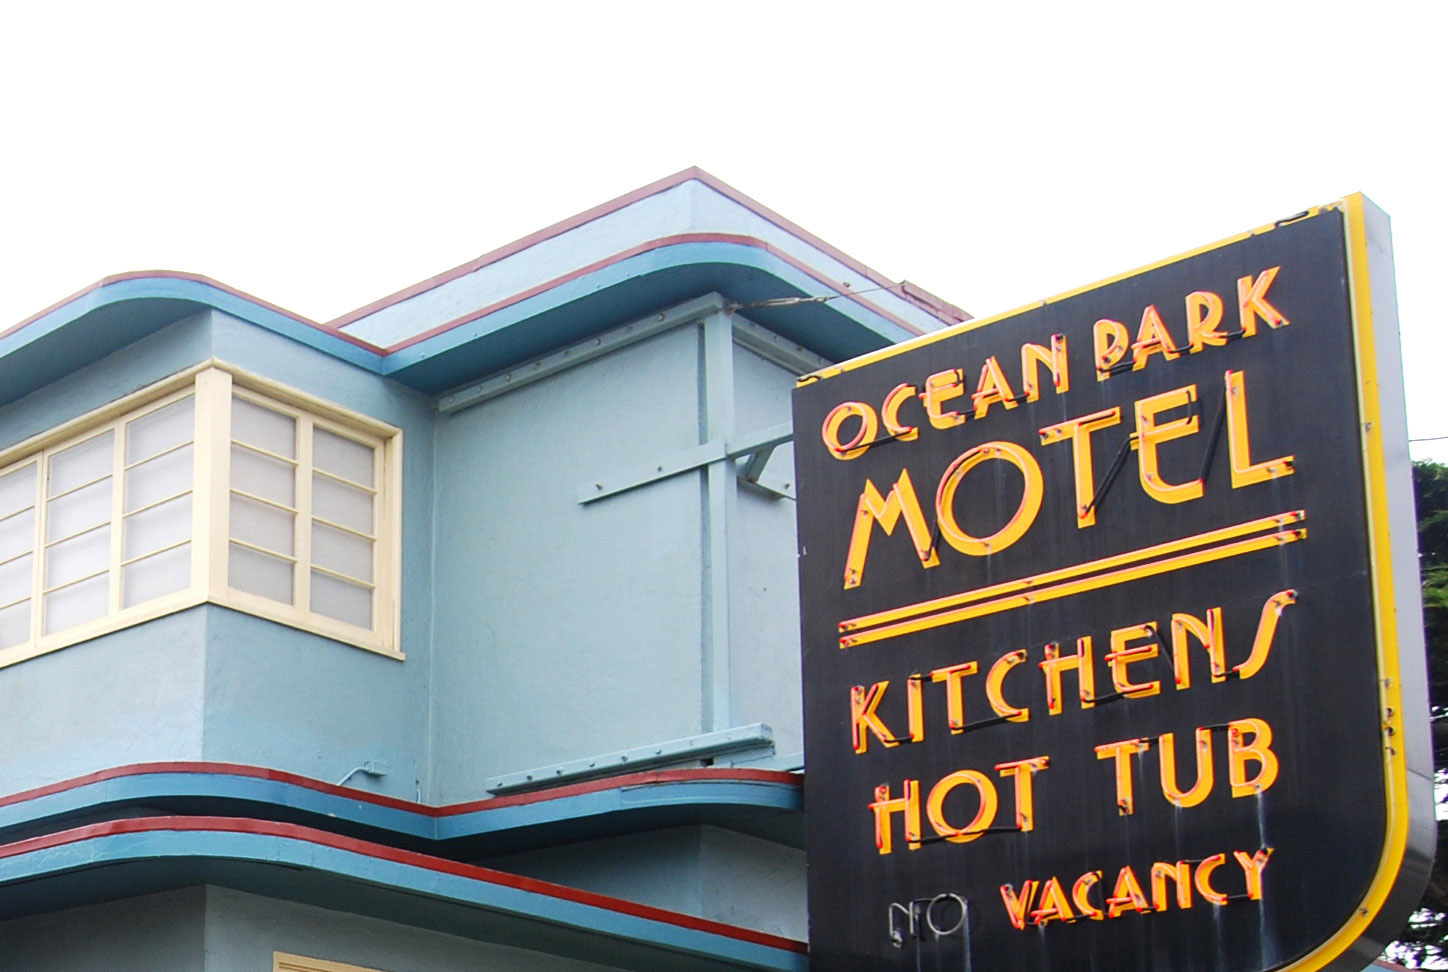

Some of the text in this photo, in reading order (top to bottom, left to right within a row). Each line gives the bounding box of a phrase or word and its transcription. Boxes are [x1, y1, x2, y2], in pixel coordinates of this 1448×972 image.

[822, 266, 1290, 461] OCEAN PARK
[843, 370, 1295, 590] MOTEL
[850, 589, 1297, 754] KITCHENS
[869, 718, 1279, 855] HOT TUB
[888, 847, 1274, 946] NO VACANCY
